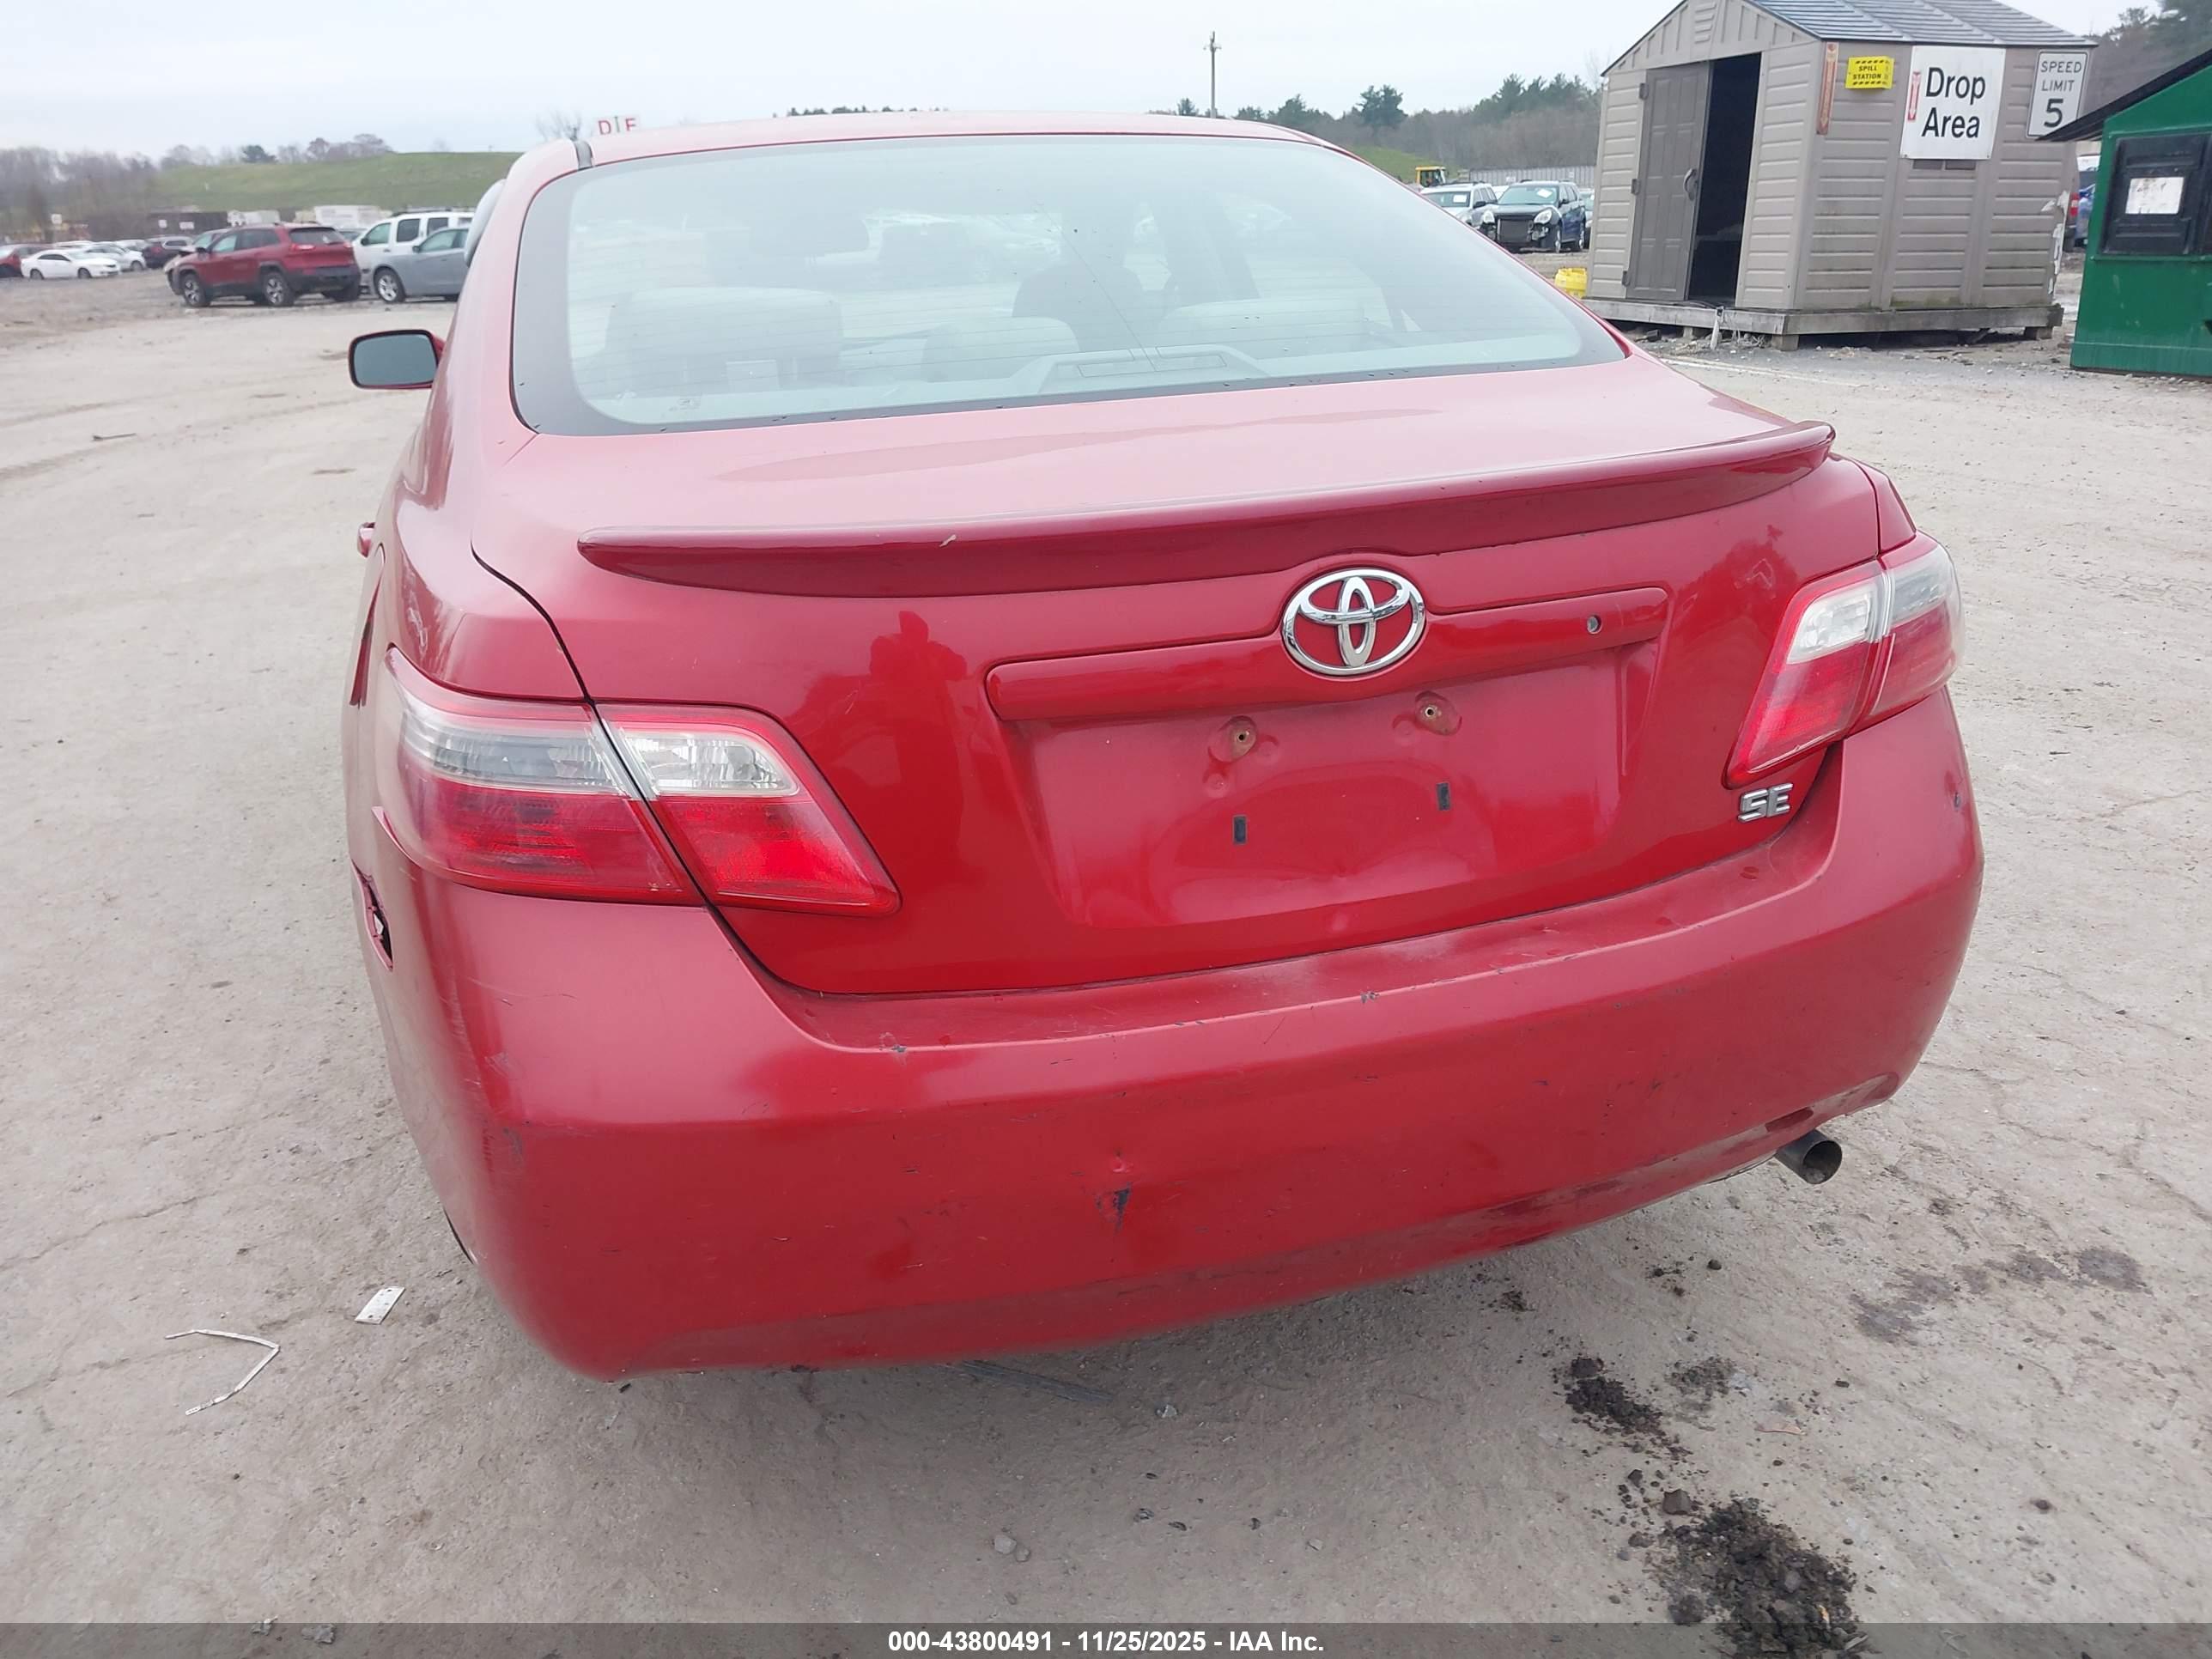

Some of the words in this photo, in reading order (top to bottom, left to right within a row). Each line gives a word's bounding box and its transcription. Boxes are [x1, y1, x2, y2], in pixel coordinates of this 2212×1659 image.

[2040, 61, 2082, 74] SPEED
[1925, 66, 1986, 105] Drop
[2041, 79, 2075, 92] LIMIT
[1921, 106, 1981, 138] Area
[2043, 98, 2064, 128] 5
[1737, 782, 1794, 823] SE
